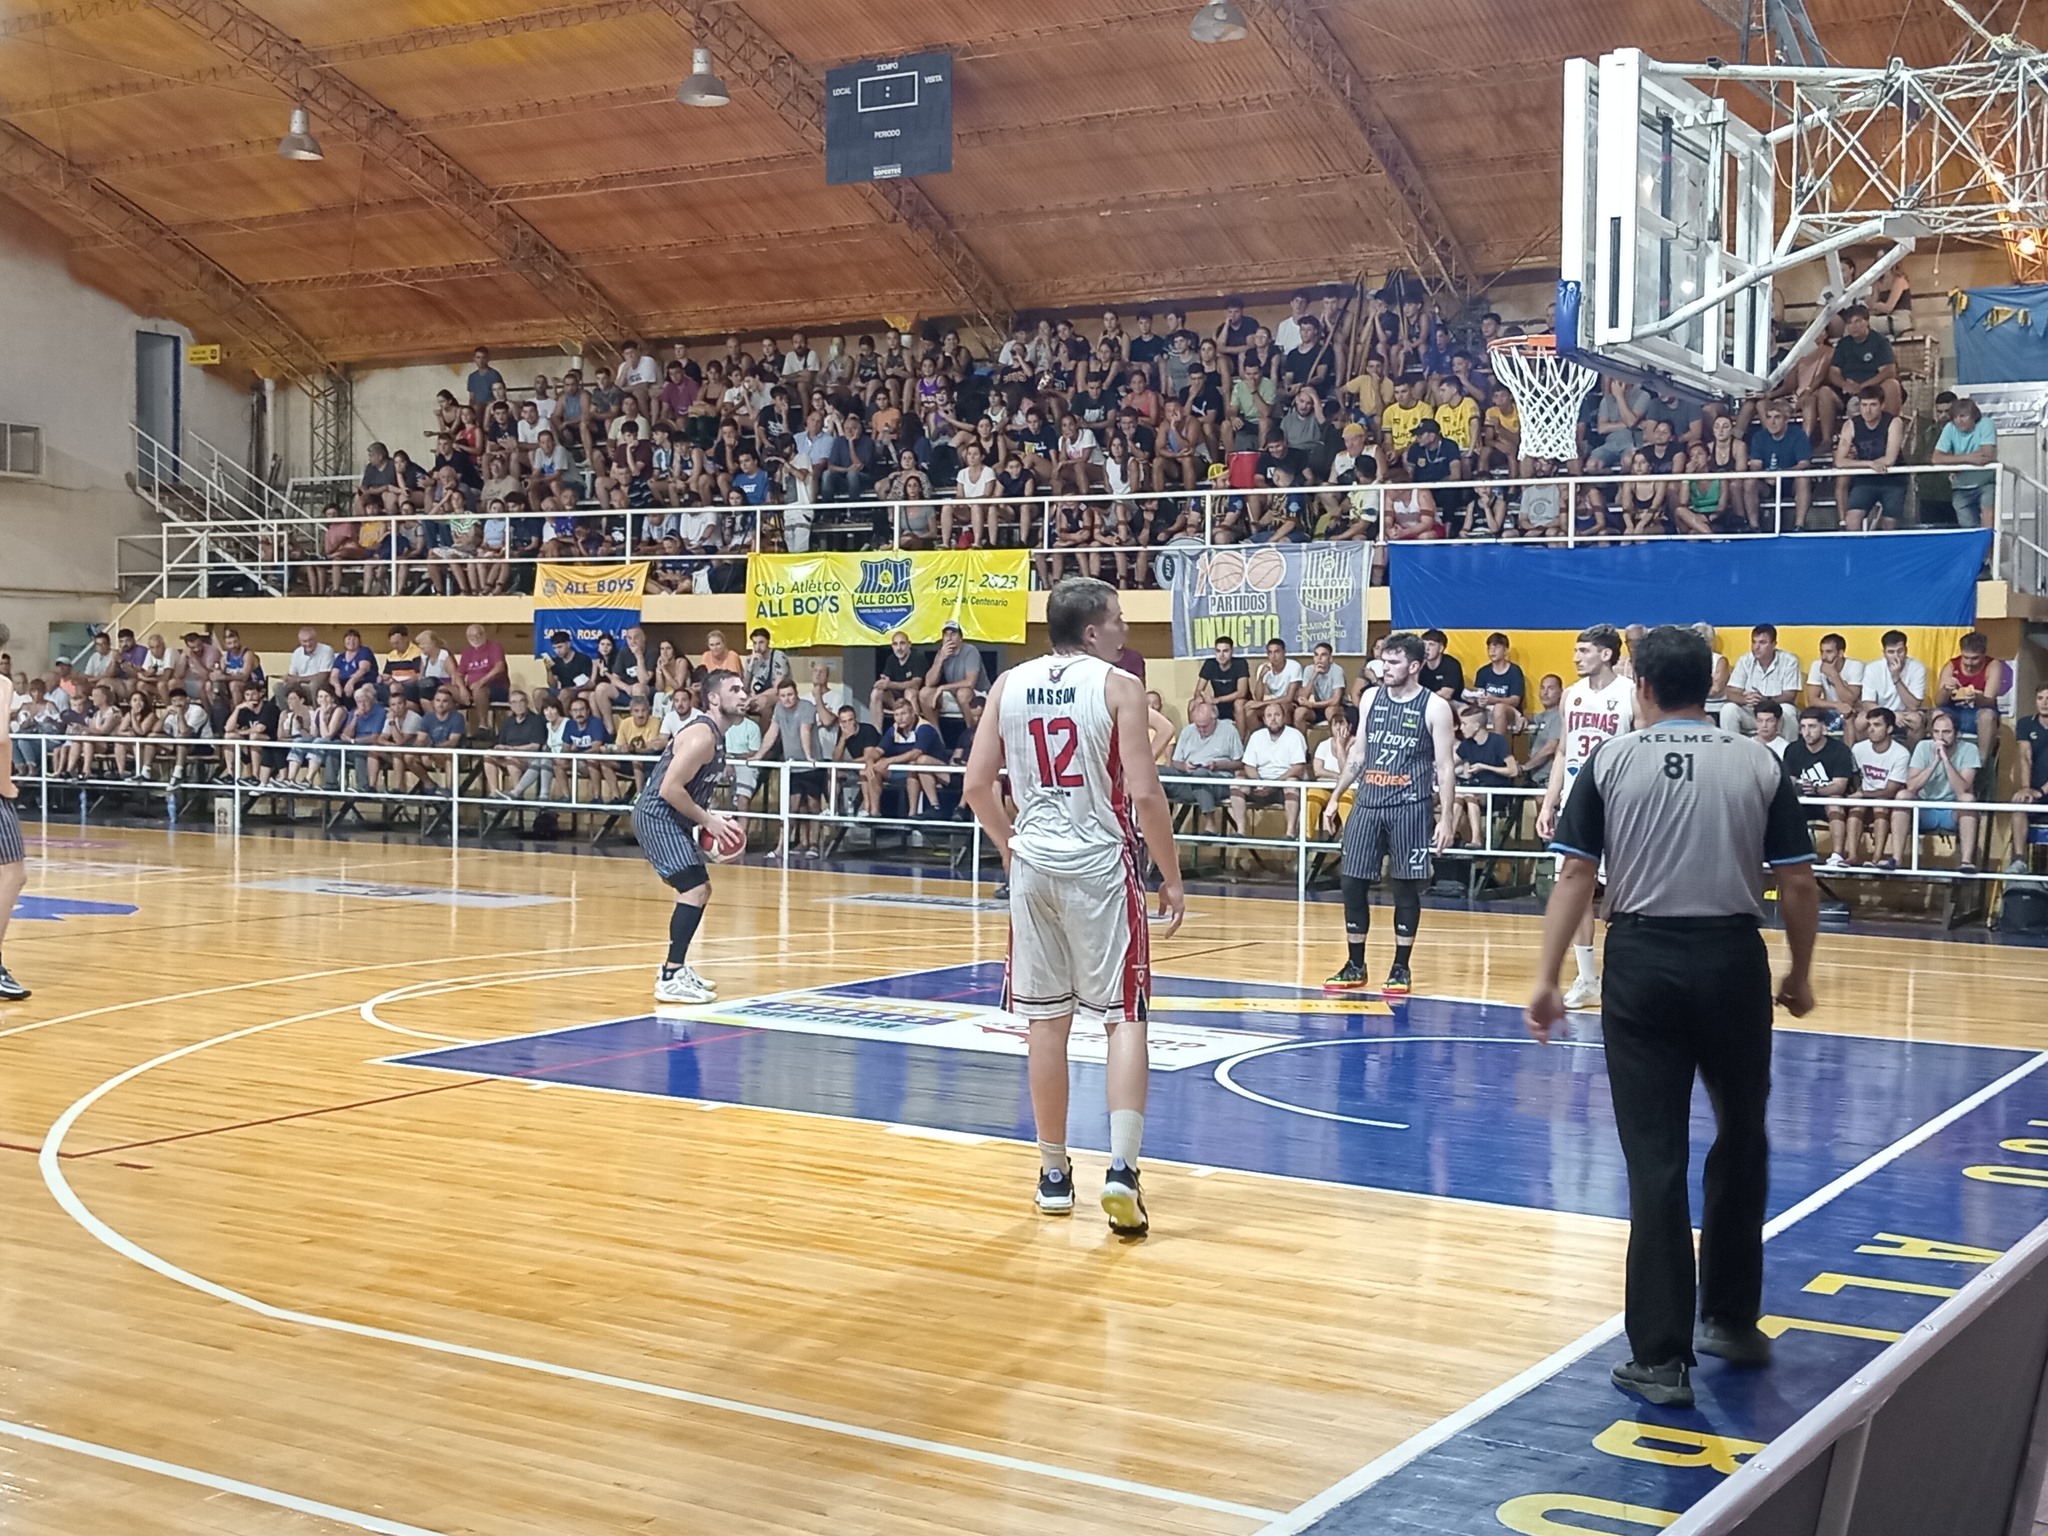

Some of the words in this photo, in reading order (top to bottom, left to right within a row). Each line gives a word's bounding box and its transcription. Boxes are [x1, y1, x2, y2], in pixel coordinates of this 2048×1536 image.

[876, 62, 899, 71] TIEMPO
[924, 75, 943, 83] VISITA
[832, 87, 852, 96] LOCAL
[874, 129, 900, 138] PERIODO
[564, 581, 589, 594] ALL
[597, 579, 635, 593] BOYS
[754, 582, 785, 597] Club
[1302, 579, 1320, 587] ALL
[1323, 578, 1350, 586] BOYS
[856, 594, 876, 605] ALL
[878, 593, 909, 605] BOYS
[971, 596, 1008, 607] Centenario
[1210, 594, 1265, 613] PARTIDOS
[756, 599, 788, 619] ALL
[793, 595, 840, 616] BOYS
[1194, 614, 1280, 650] INVICTO
[1297, 620, 1330, 631] CAMINO
[1026, 687, 1076, 705] MASSON
[1368, 730, 1384, 743] all
[1384, 730, 1419, 749] boys
[1639, 733, 1713, 743] KELME
[1028, 716, 1085, 788] 12
[1375, 748, 1398, 766] 27
[1663, 752, 1694, 781] 81
[1409, 848, 1428, 864] 27
